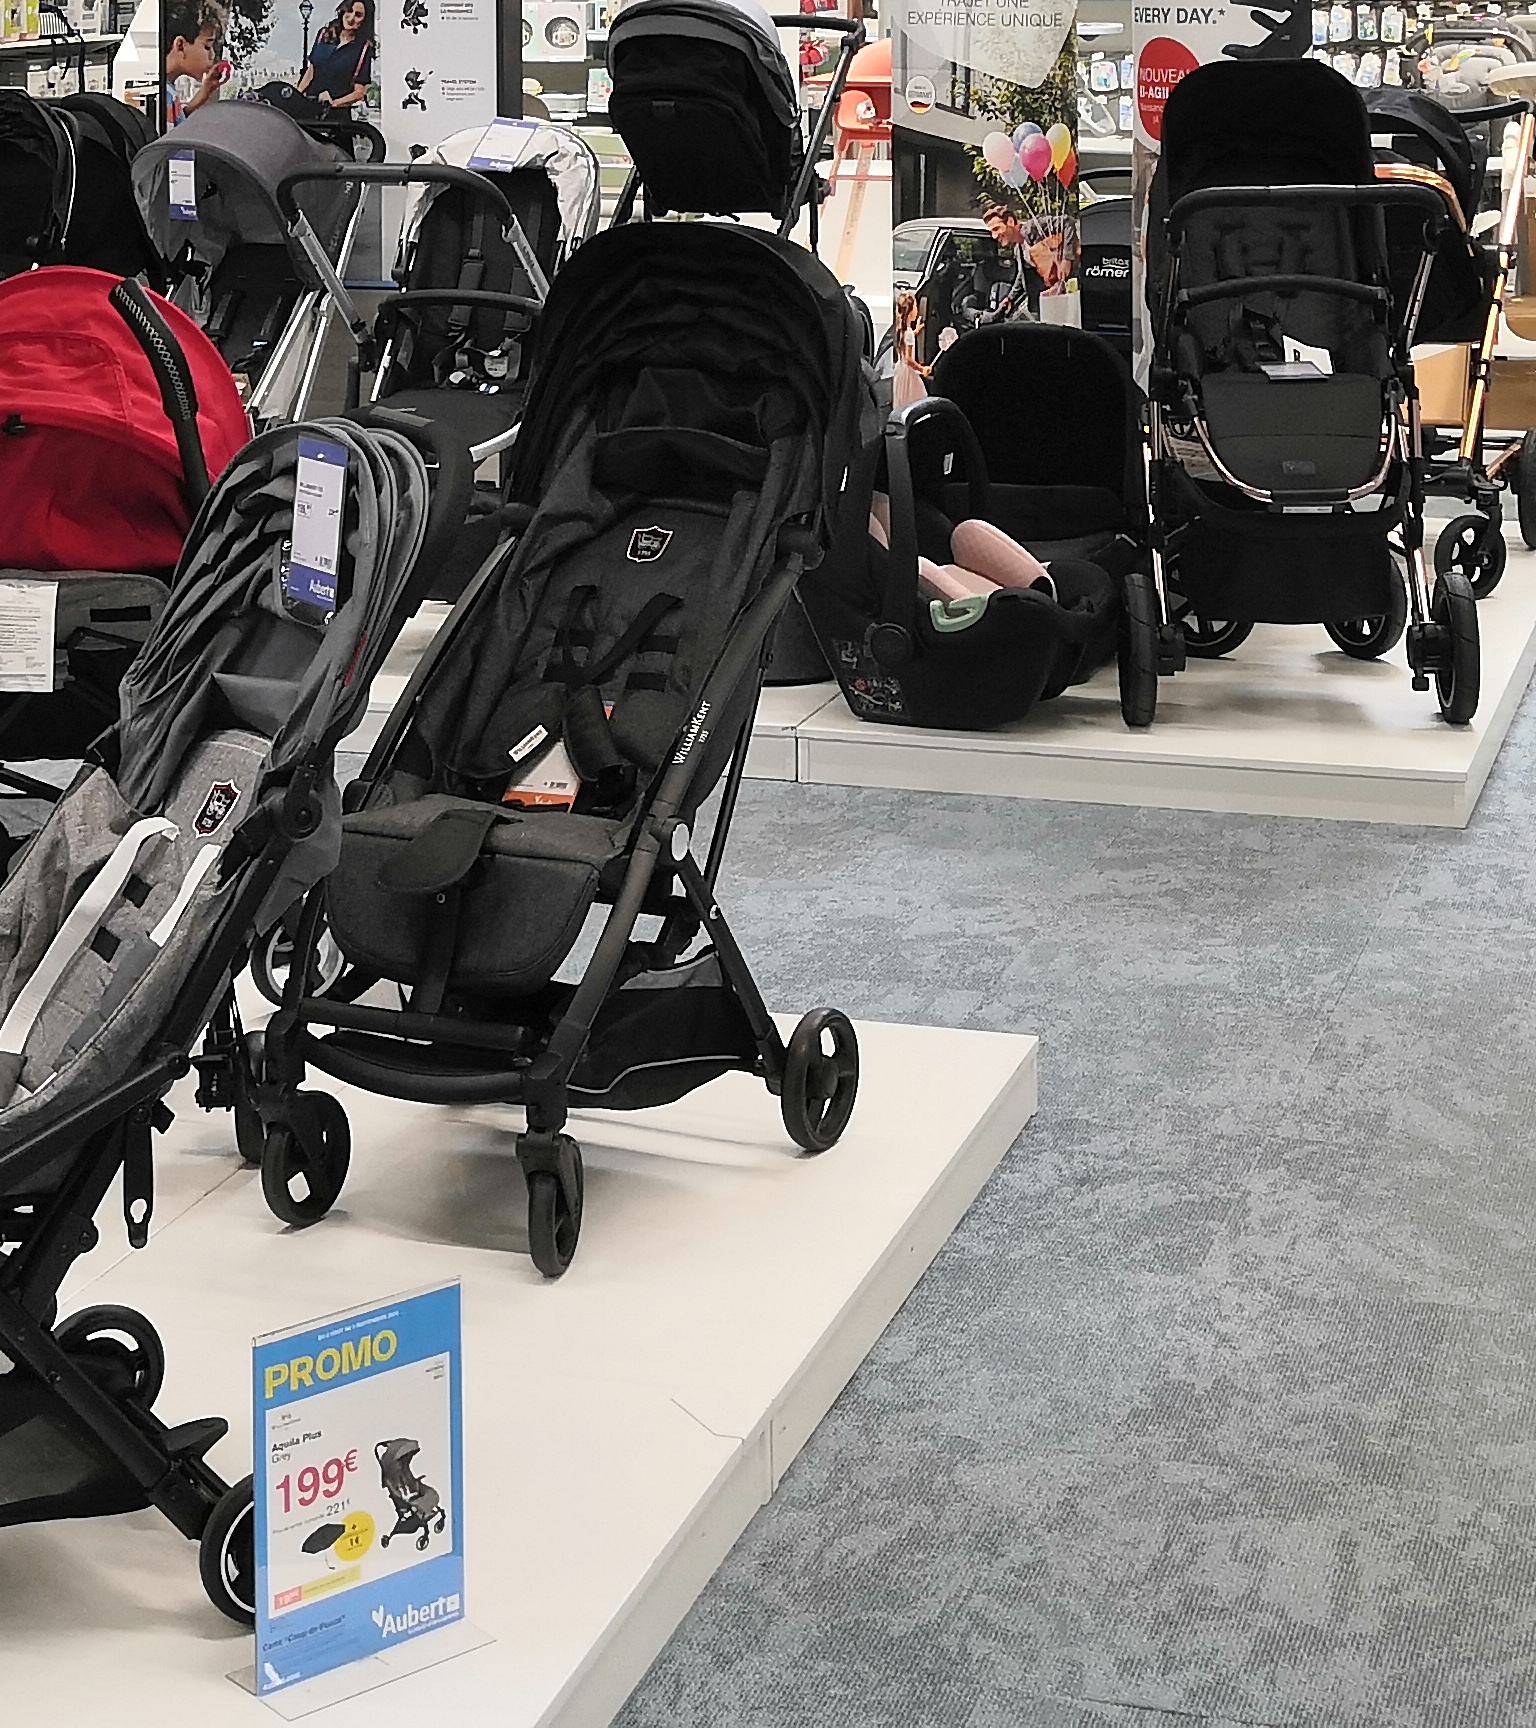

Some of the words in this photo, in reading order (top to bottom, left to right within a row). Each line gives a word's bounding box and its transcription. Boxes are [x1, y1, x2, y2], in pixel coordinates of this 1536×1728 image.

[907, 9, 996, 26] EXPÉRIENCE
[1134, 7, 1173, 25] EVERY
[1086, 266, 1129, 277] römer
[265, 1330, 397, 1399] PROMO
[272, 1437, 301, 1452] Aquila
[302, 1431, 322, 1443] Plus
[276, 1448, 358, 1513] 199€
[382, 1594, 447, 1638] Aubert
